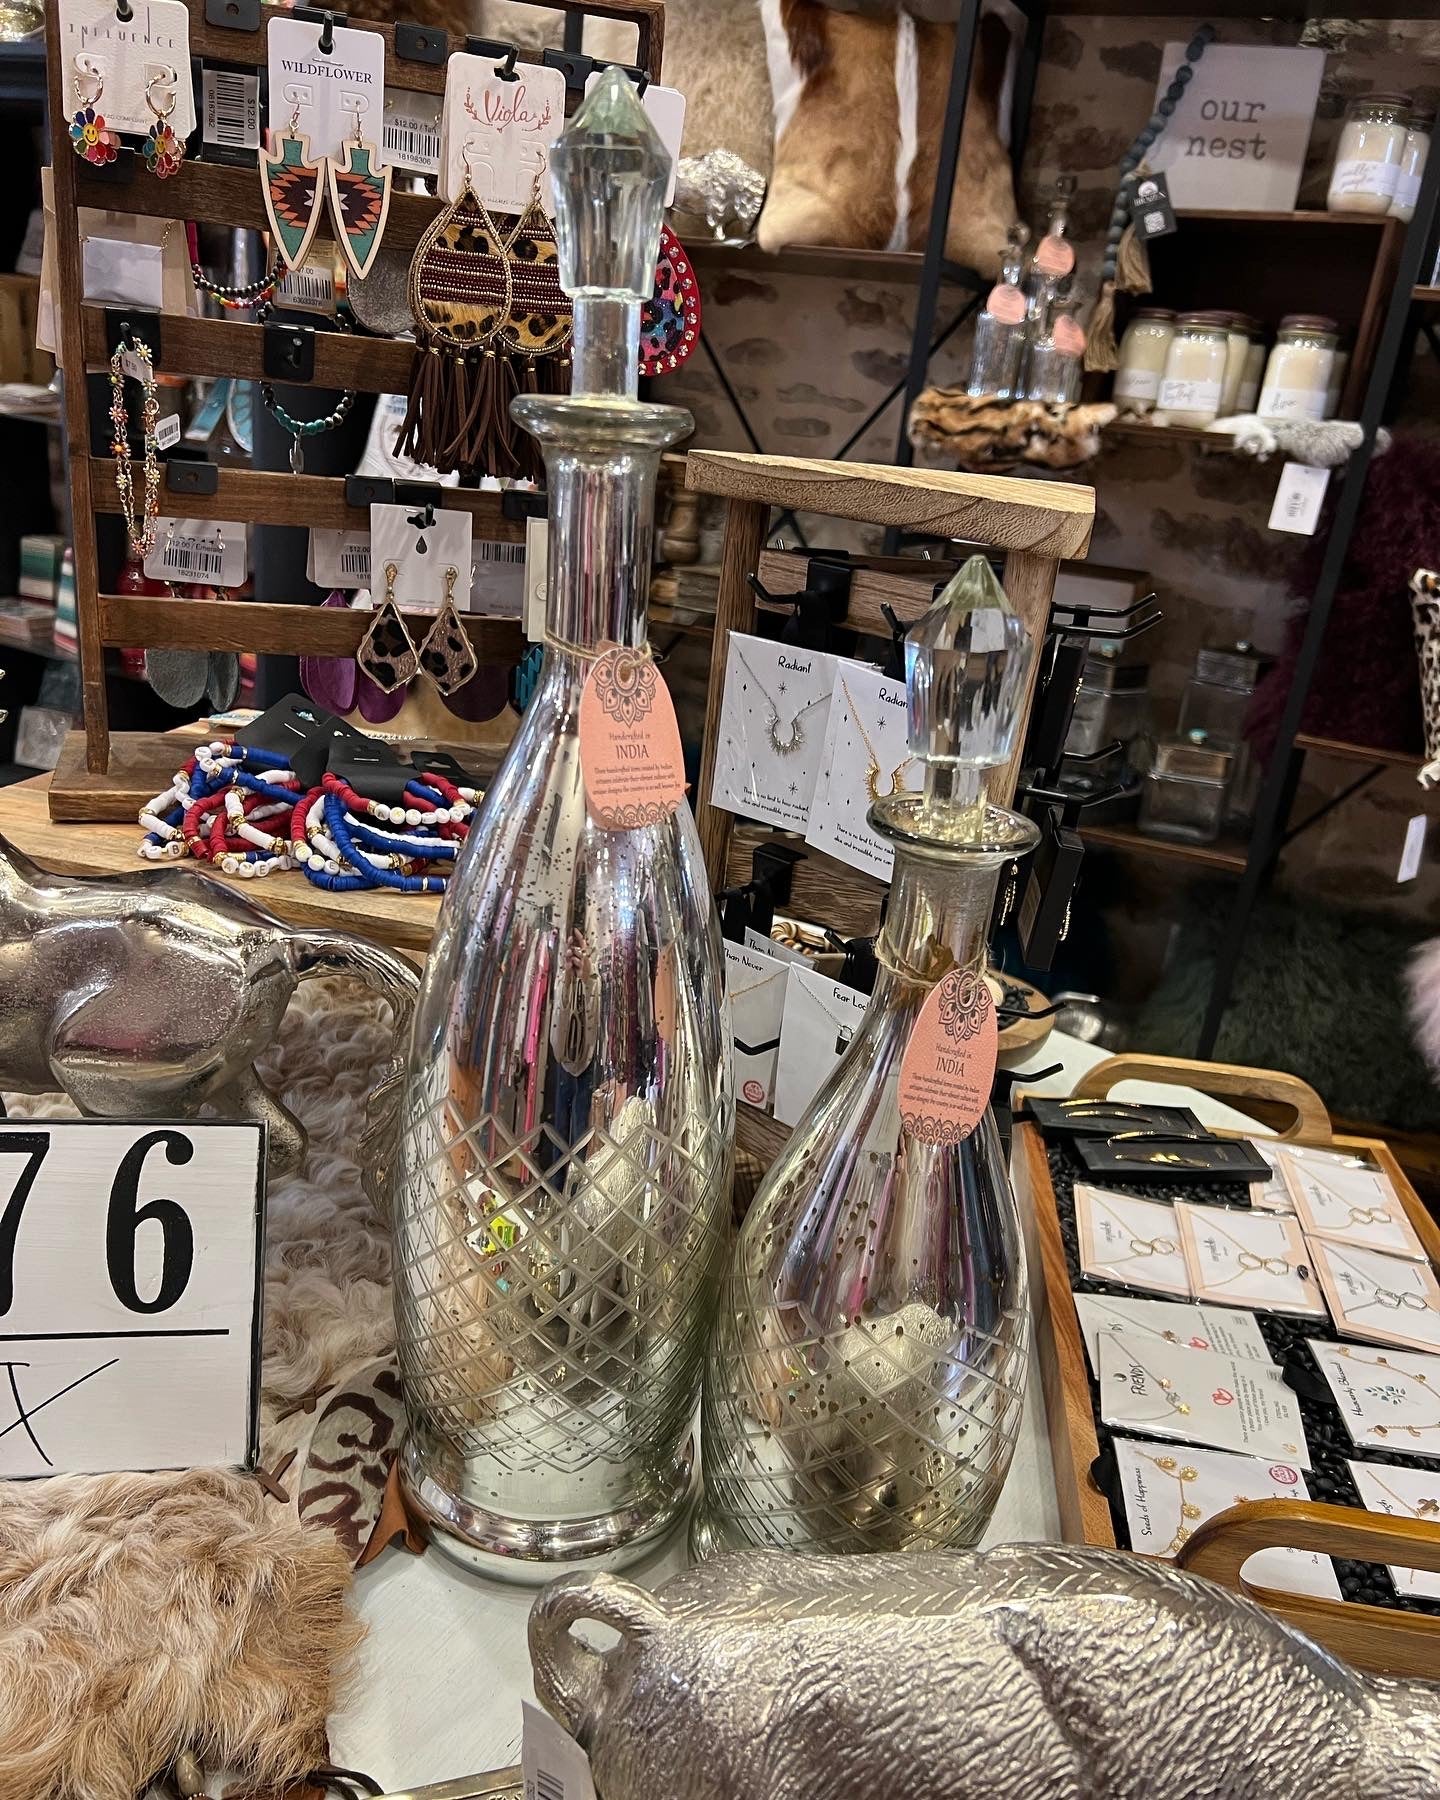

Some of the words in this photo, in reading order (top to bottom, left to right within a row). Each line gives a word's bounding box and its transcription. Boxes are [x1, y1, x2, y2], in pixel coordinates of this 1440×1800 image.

[281, 59, 373, 84] WILDFLOWER
[484, 85, 538, 133] Viola
[1200, 99, 1266, 124] our
[394, 118, 418, 130] $12.00
[1184, 132, 1268, 161] nest
[777, 655, 812, 674] Radiant
[878, 687, 909, 709] Radian
[609, 728, 644, 743] Handcrafted
[615, 744, 650, 760] INDIA
[741, 955, 764, 971] Never
[833, 986, 850, 1003] Fear
[852, 995, 869, 1011] Loc
[935, 1043, 967, 1059] Handcrafted
[935, 1056, 965, 1077] INDIA
[1128, 1363, 1149, 1397] FRIENDS
[1135, 1467, 1148, 1502] Happiness
[1141, 1501, 1149, 1513] of
[1141, 1512, 1152, 1537] Seeds
